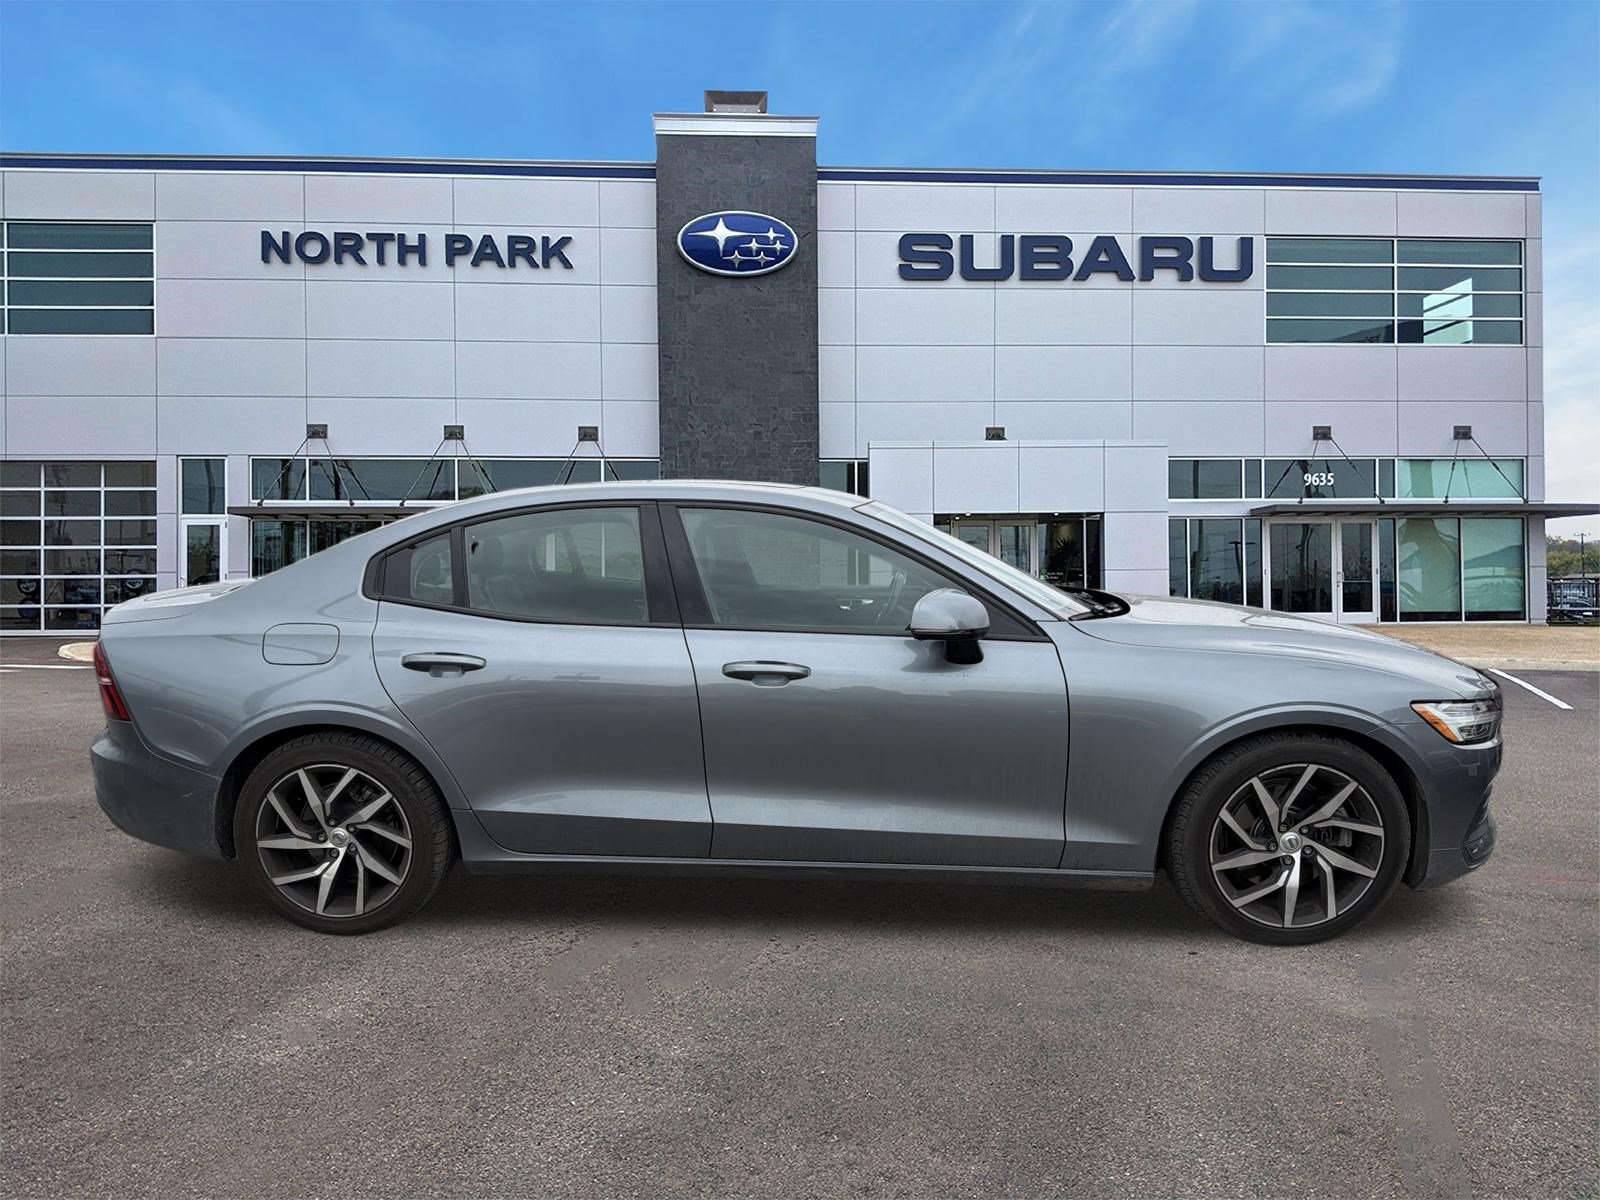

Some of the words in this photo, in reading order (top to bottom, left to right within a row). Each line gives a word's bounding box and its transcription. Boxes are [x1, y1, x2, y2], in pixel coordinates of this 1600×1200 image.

[260, 230, 427, 267] NORTH
[444, 233, 574, 269] PARK
[898, 232, 1254, 282] SUBARU
[1303, 472, 1335, 486] 9635
